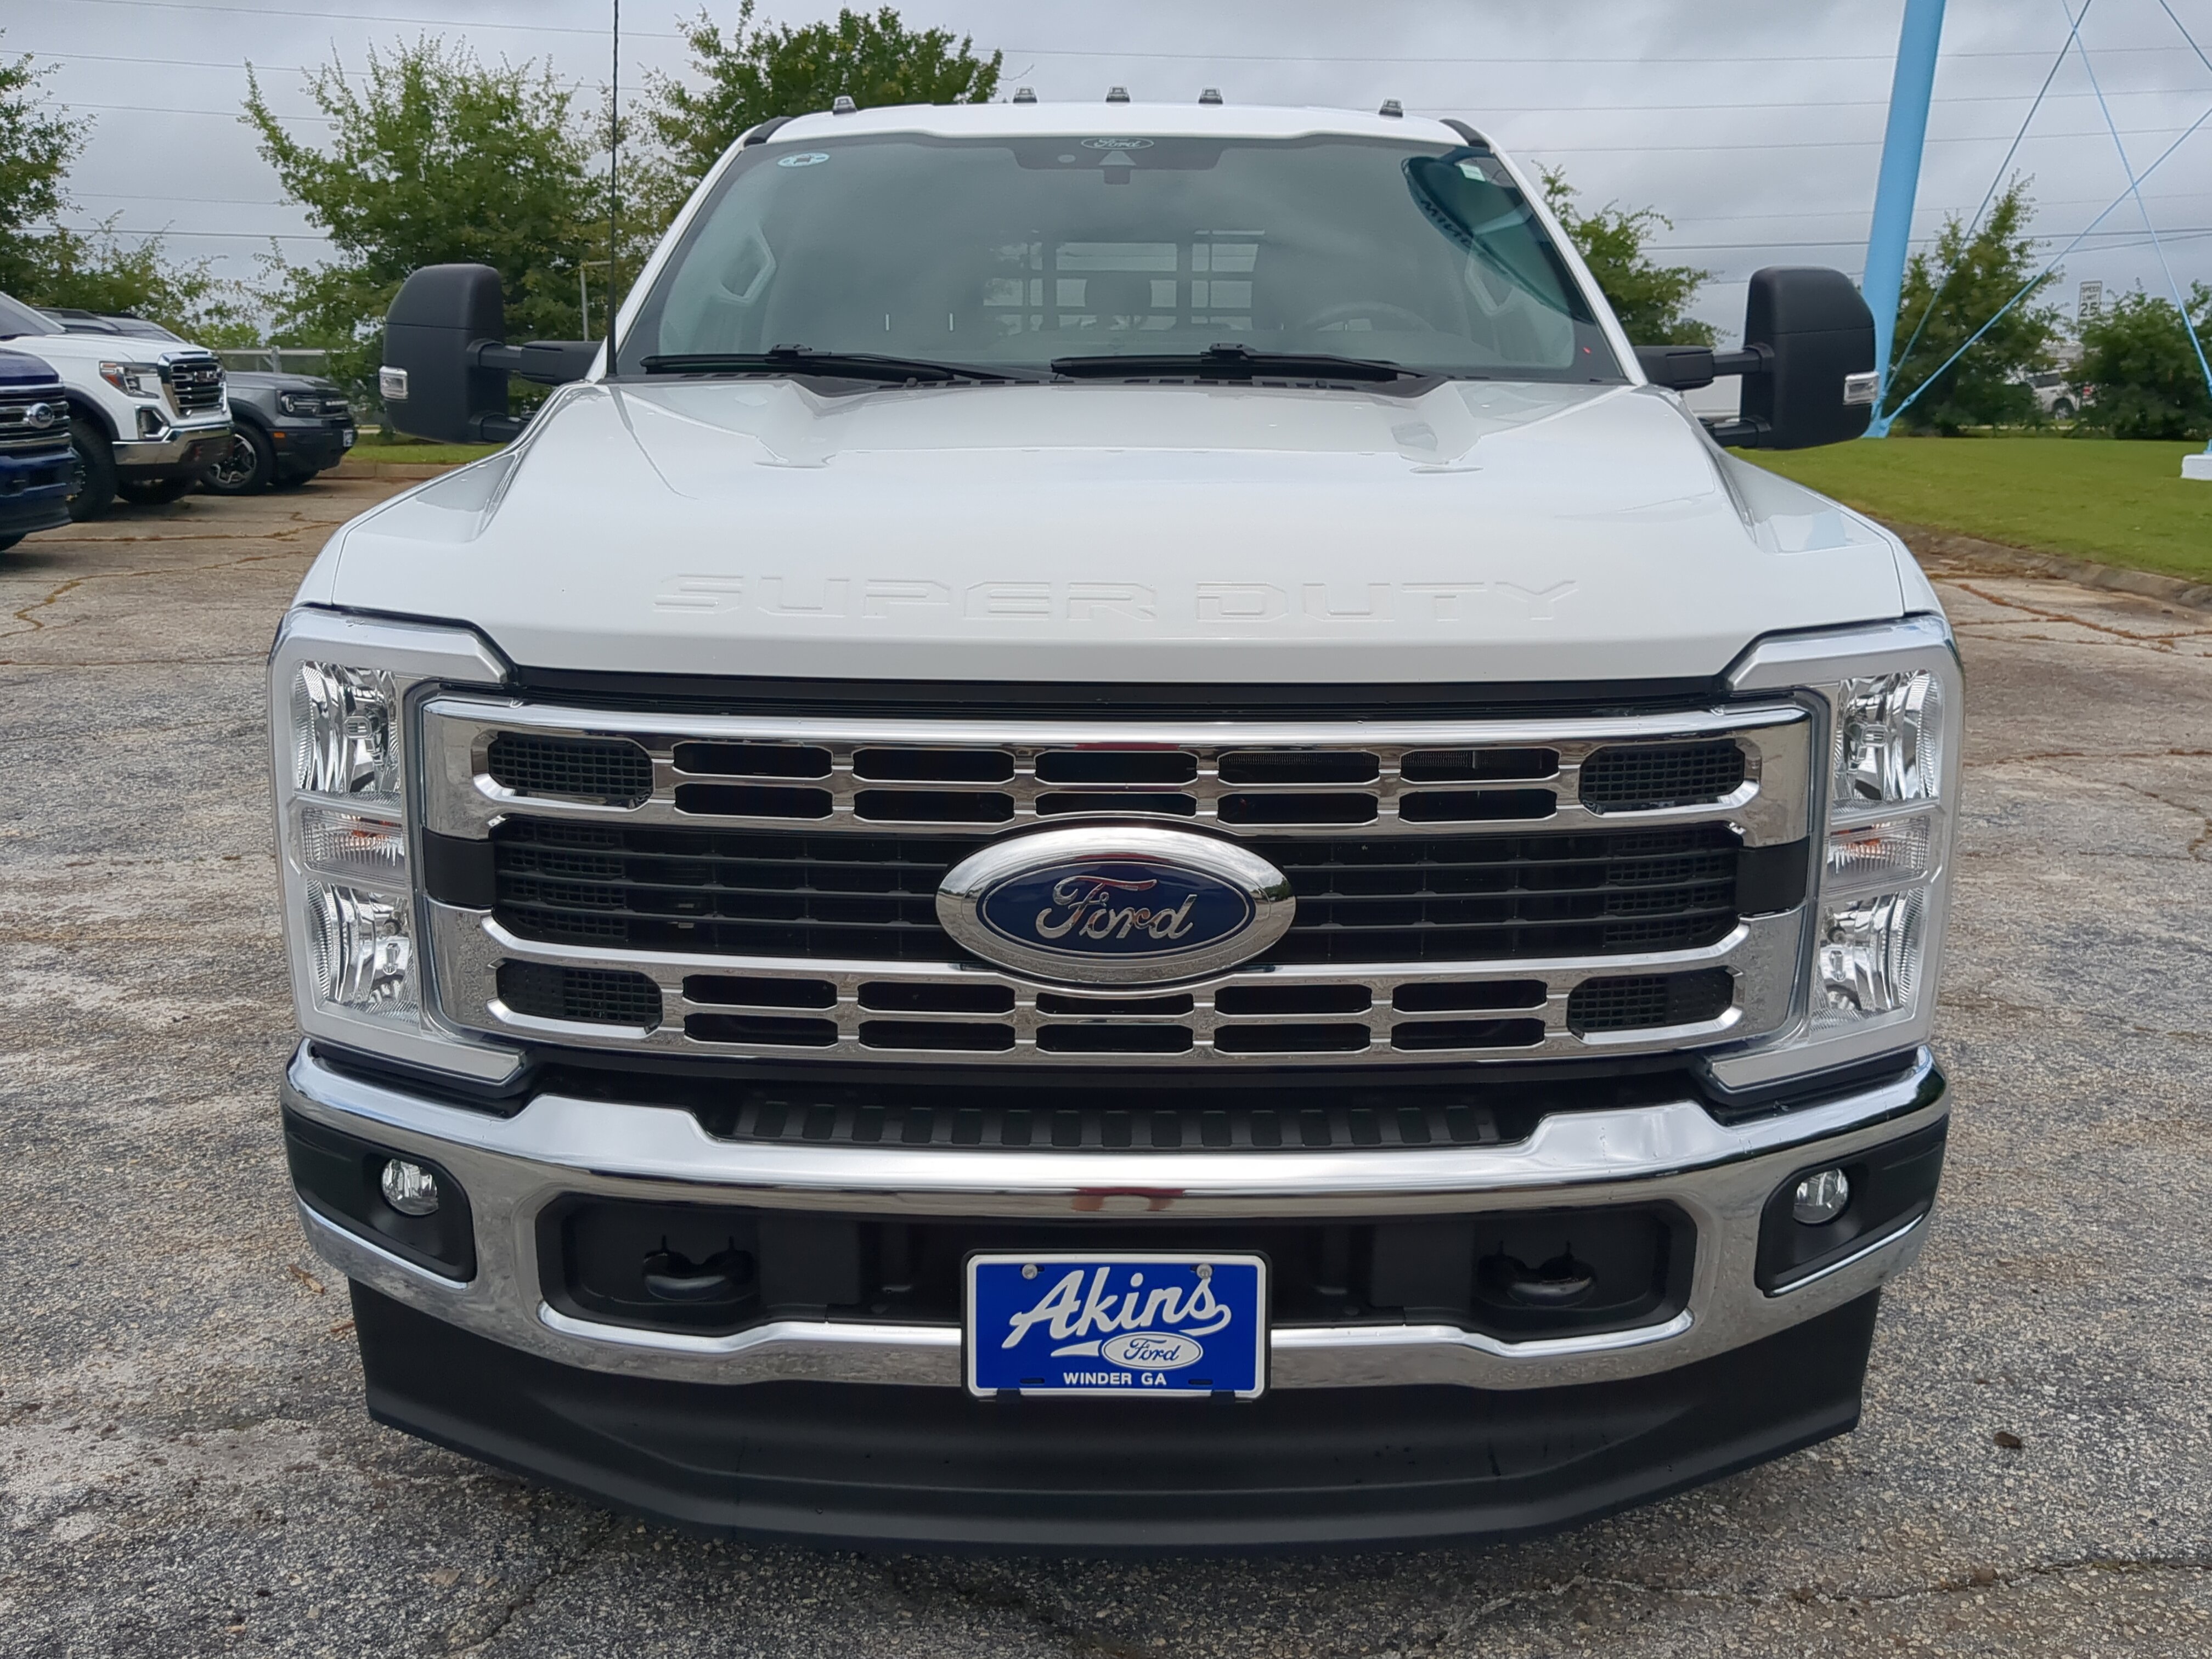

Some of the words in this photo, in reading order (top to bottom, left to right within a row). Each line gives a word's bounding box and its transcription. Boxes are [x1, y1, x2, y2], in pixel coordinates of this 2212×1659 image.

[1093, 138, 1141, 148] Ford
[2080, 302, 2098, 317] 25
[652, 573, 1159, 622] SUPER
[1195, 579, 1579, 622] DUTY
[1035, 875, 1198, 939] Ford
[1001, 1266, 1232, 1349] Akins
[1123, 1338, 1182, 1362] Ford
[1063, 1372, 1132, 1385] WINDER
[1141, 1373, 1167, 1386] GA
